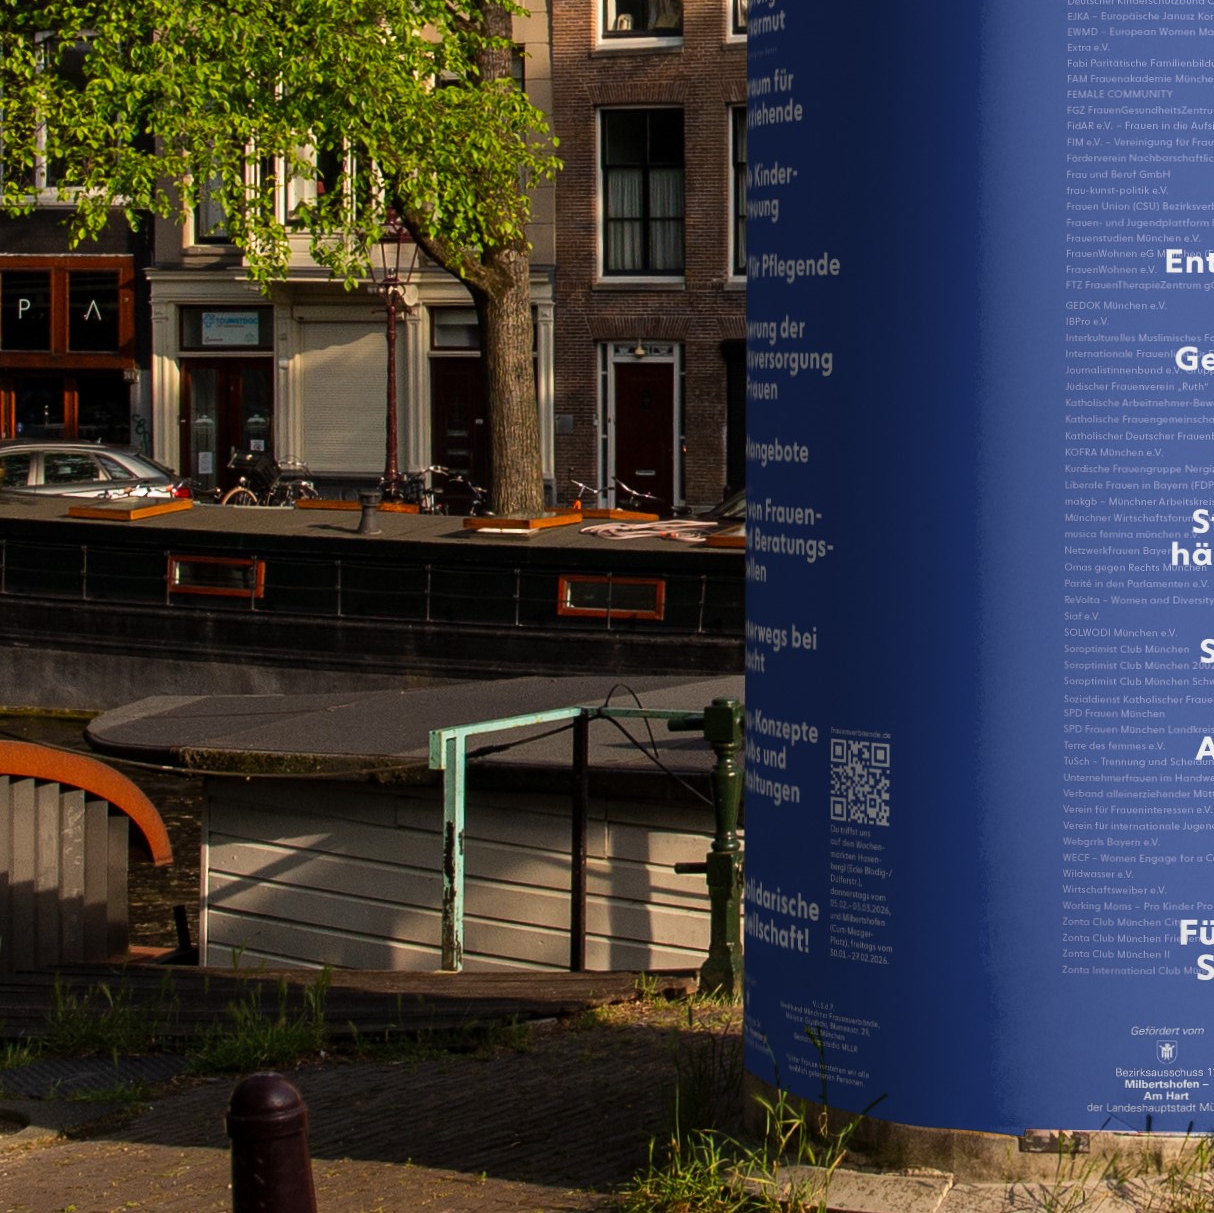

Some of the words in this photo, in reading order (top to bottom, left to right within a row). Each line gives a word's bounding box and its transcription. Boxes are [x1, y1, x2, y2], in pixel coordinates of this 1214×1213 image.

[1094, 43, 1110, 51] e.V.
[1068, 75, 1087, 83] FAM
[1091, 74, 1172, 83] Frauenakademie
[1067, 90, 1104, 98] FEMALE
[1107, 90, 1173, 98] COMMUNITY
[1097, 121, 1113, 130] e.V.
[1126, 121, 1158, 129] Frauen
[1173, 121, 1187, 129] die
[1067, 170, 1087, 178] Frau
[1090, 170, 1108, 178] und
[1111, 170, 1136, 178] Beruf
[1139, 170, 1170, 178] GmbH
[762, 252, 840, 283] Pflegende
[1066, 301, 1100, 309] GEDOK
[1104, 301, 1147, 309] München
[1150, 301, 1167, 309] e.V.
[781, 315, 805, 338] der
[1066, 448, 1097, 456] KOFRA
[1100, 448, 1143, 456] München
[1147, 448, 1163, 456] e.V.
[766, 498, 822, 525] Frauen-
[755, 527, 833, 563] Beratungs-
[1065, 628, 1110, 637] SOLWODI
[1114, 629, 1157, 637] München
[1161, 629, 1177, 637] e.V.
[792, 625, 816, 650] bei
[764, 746, 786, 769] und
[1063, 869, 1115, 878] Wildwasser
[1118, 870, 1134, 878] e.V.
[1063, 949, 1089, 957] Zonta
[1092, 950, 1114, 958] Club
[1118, 950, 1161, 958] München
[1131, 1027, 1180, 1035] Gefördert
[1116, 1068, 1203, 1077] Bezirksausschuss
[1125, 1080, 1199, 1088] Milbertshofen
[1144, 1092, 1162, 1100] Am
[1166, 1092, 1189, 1100] Hart
[1087, 1103, 1103, 1112] der
[1107, 1103, 1196, 1114] Landeshauptstadt
